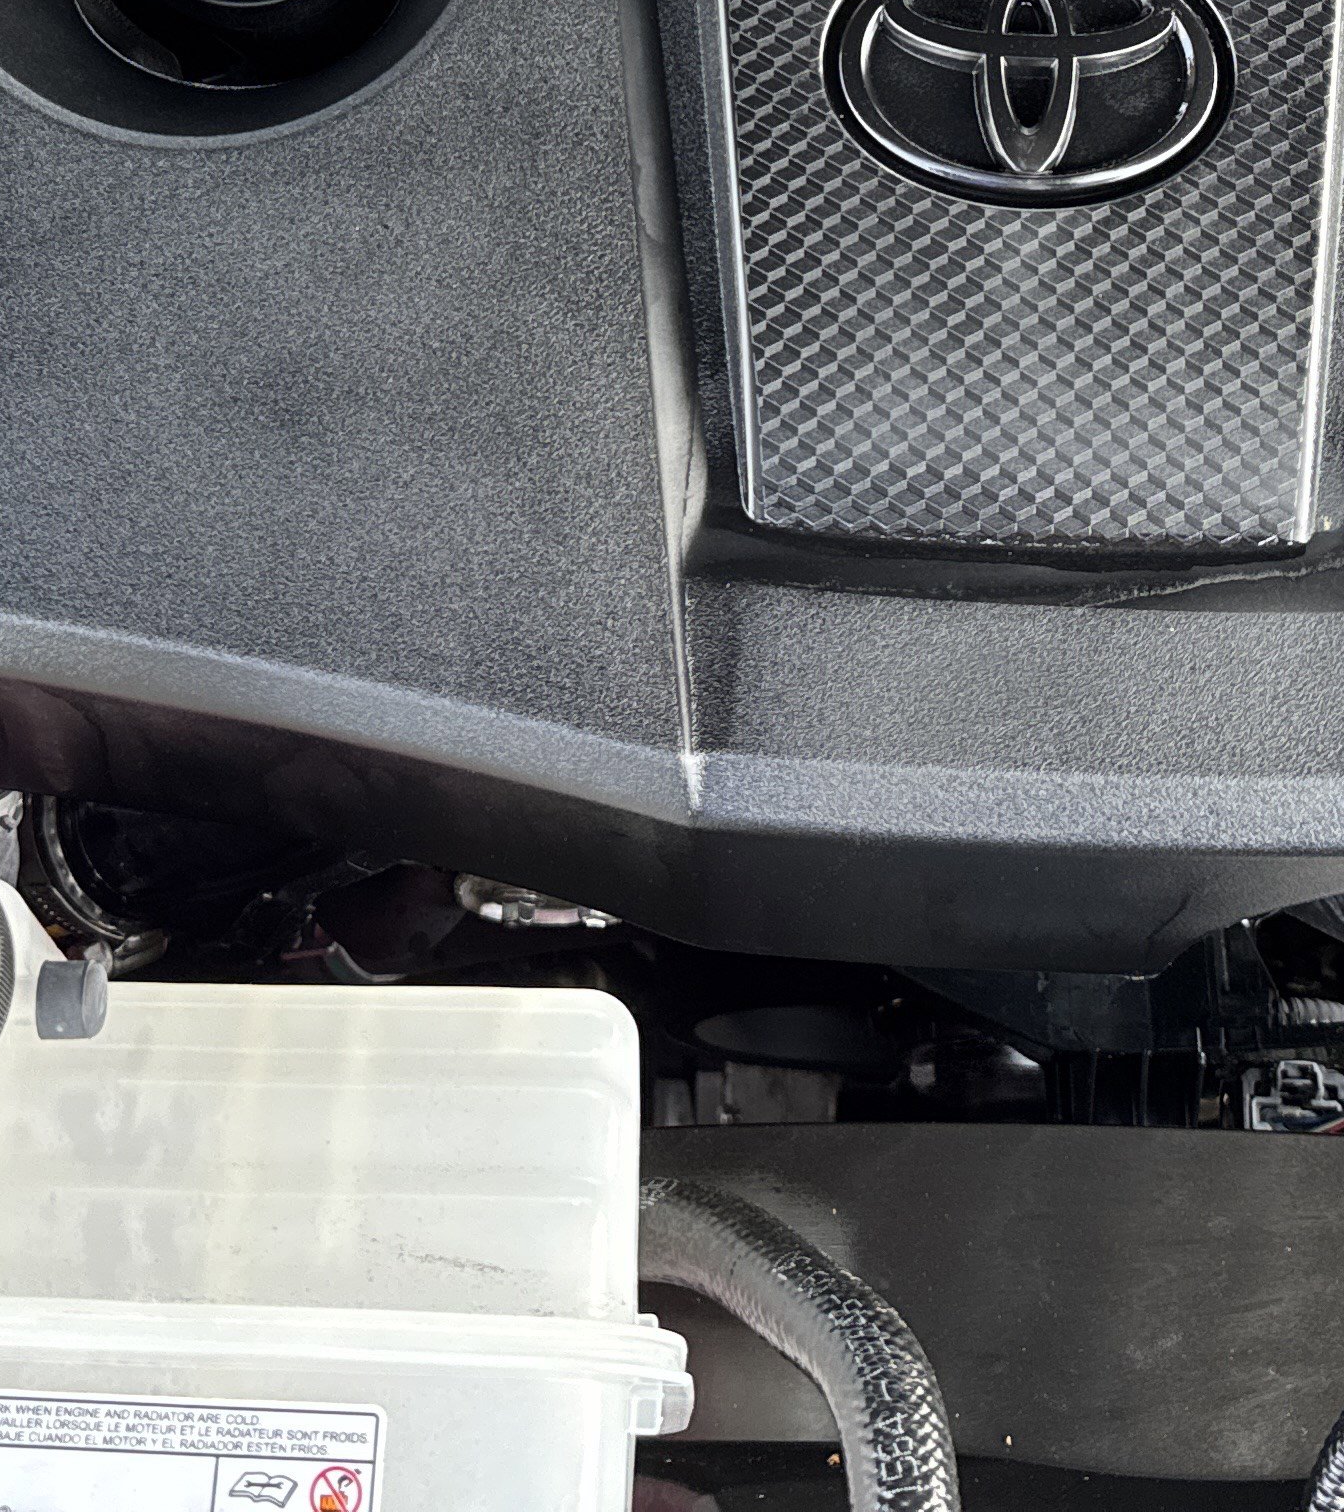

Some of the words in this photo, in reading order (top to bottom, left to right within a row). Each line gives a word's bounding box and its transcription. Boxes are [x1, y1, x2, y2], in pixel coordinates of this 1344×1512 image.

[15, 1404, 52, 1416] WHEN
[55, 1405, 101, 1419] ENGINE
[104, 1408, 131, 1421] AND
[133, 1409, 195, 1423] RADIATOR
[197, 1412, 222, 1424] ARE
[28, 1431, 82, 1445] CUANDO
[84, 1433, 99, 1446] EL
[102, 1434, 147, 1447] MOTOR
[161, 1438, 175, 1449] EL
[179, 1438, 243, 1452] RADIADOR
[45, 1418, 104, 1432] LORSQUE
[107, 1421, 122, 1433] LE
[124, 1423, 177, 1436] MOTEUR
[180, 1424, 195, 1437] ET
[197, 1425, 212, 1437] LE
[215, 1426, 284, 1440] RADIATEUR
[286, 1429, 320, 1442] SONT
[322, 1430, 370, 1444] FROIDS.
